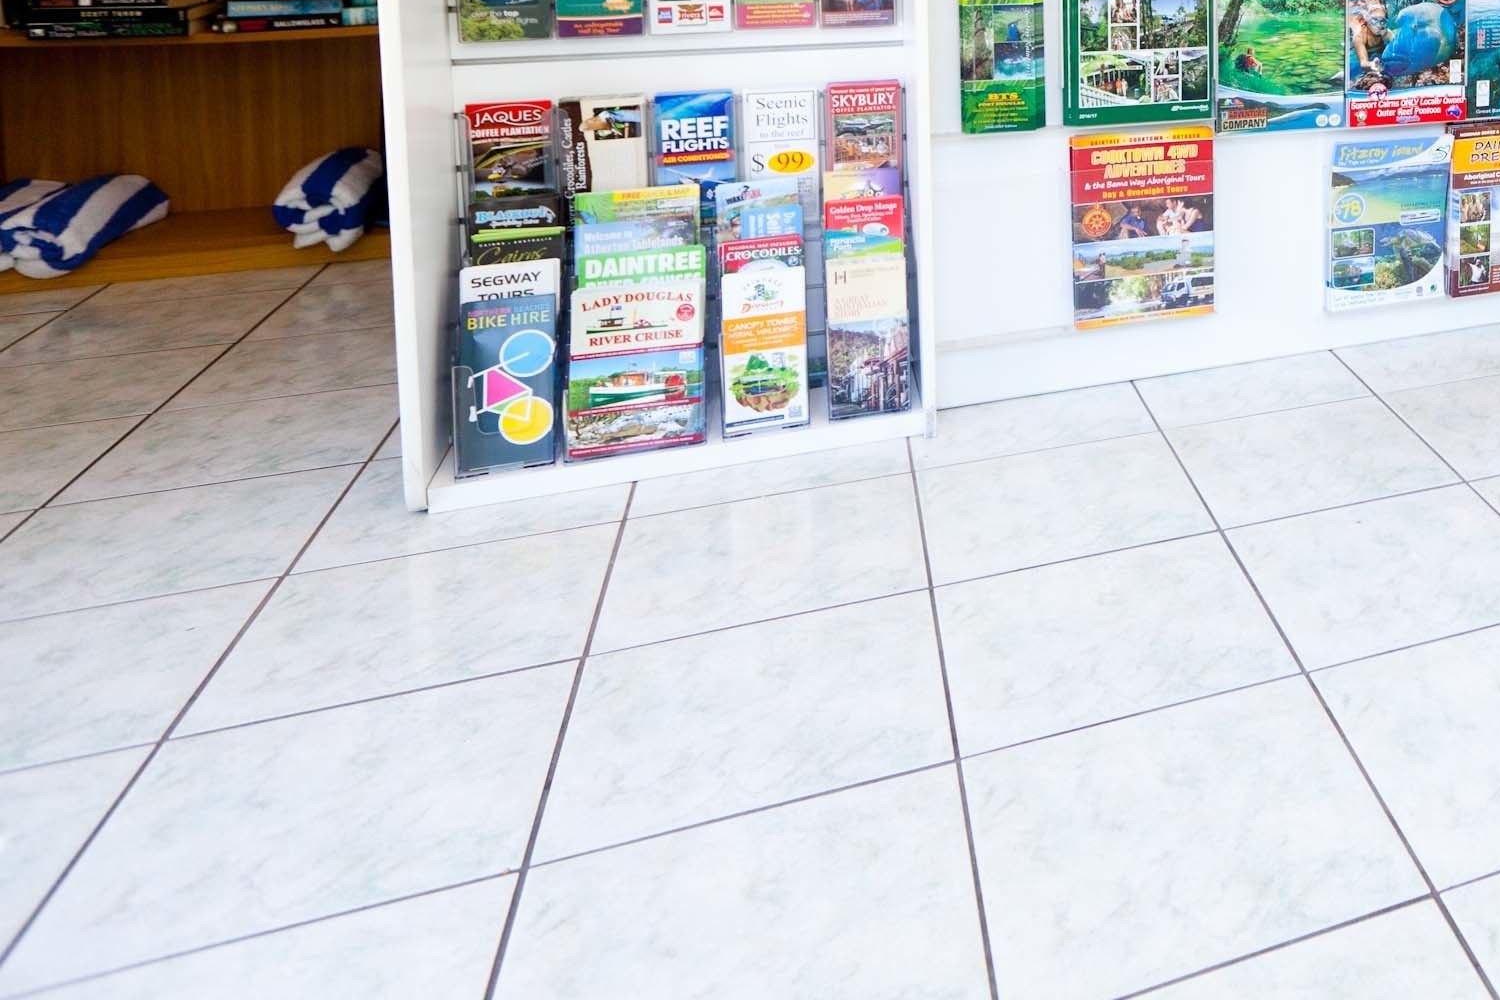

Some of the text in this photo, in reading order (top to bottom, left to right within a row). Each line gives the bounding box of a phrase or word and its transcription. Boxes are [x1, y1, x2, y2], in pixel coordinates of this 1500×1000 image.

[755, 96, 806, 109] Scenic
[831, 92, 895, 107] SKYBURY
[1351, 100, 1377, 111] Support
[1378, 99, 1399, 108] Cairns
[1401, 98, 1419, 107] ONLY
[1420, 98, 1442, 107] Locally
[474, 109, 542, 127] JAQUES
[1376, 106, 1441, 117] Outer Reef Pontoon
[755, 112, 808, 128] Flights
[1223, 119, 1266, 130] COMPANY
[471, 127, 500, 138] COFFEE
[661, 115, 729, 141] REEF
[662, 137, 730, 154] FLIGHTS
[1129, 178, 1146, 189] Way
[1147, 174, 1185, 186] Aboriginal
[1186, 174, 1205, 182] Tours
[1464, 171, 1494, 182] Aboriginal
[1103, 191, 1118, 199] Day
[1127, 186, 1165, 198] Overnight
[1167, 185, 1188, 193] Tours
[585, 250, 701, 278] DAINTREE
[471, 271, 541, 288] SEGWAY
[477, 289, 535, 300] TOURS
[582, 291, 693, 312] LADY DOUGLAS
[467, 310, 550, 330] BIKE HIRE
[589, 329, 683, 347] RIVER CRUISE
